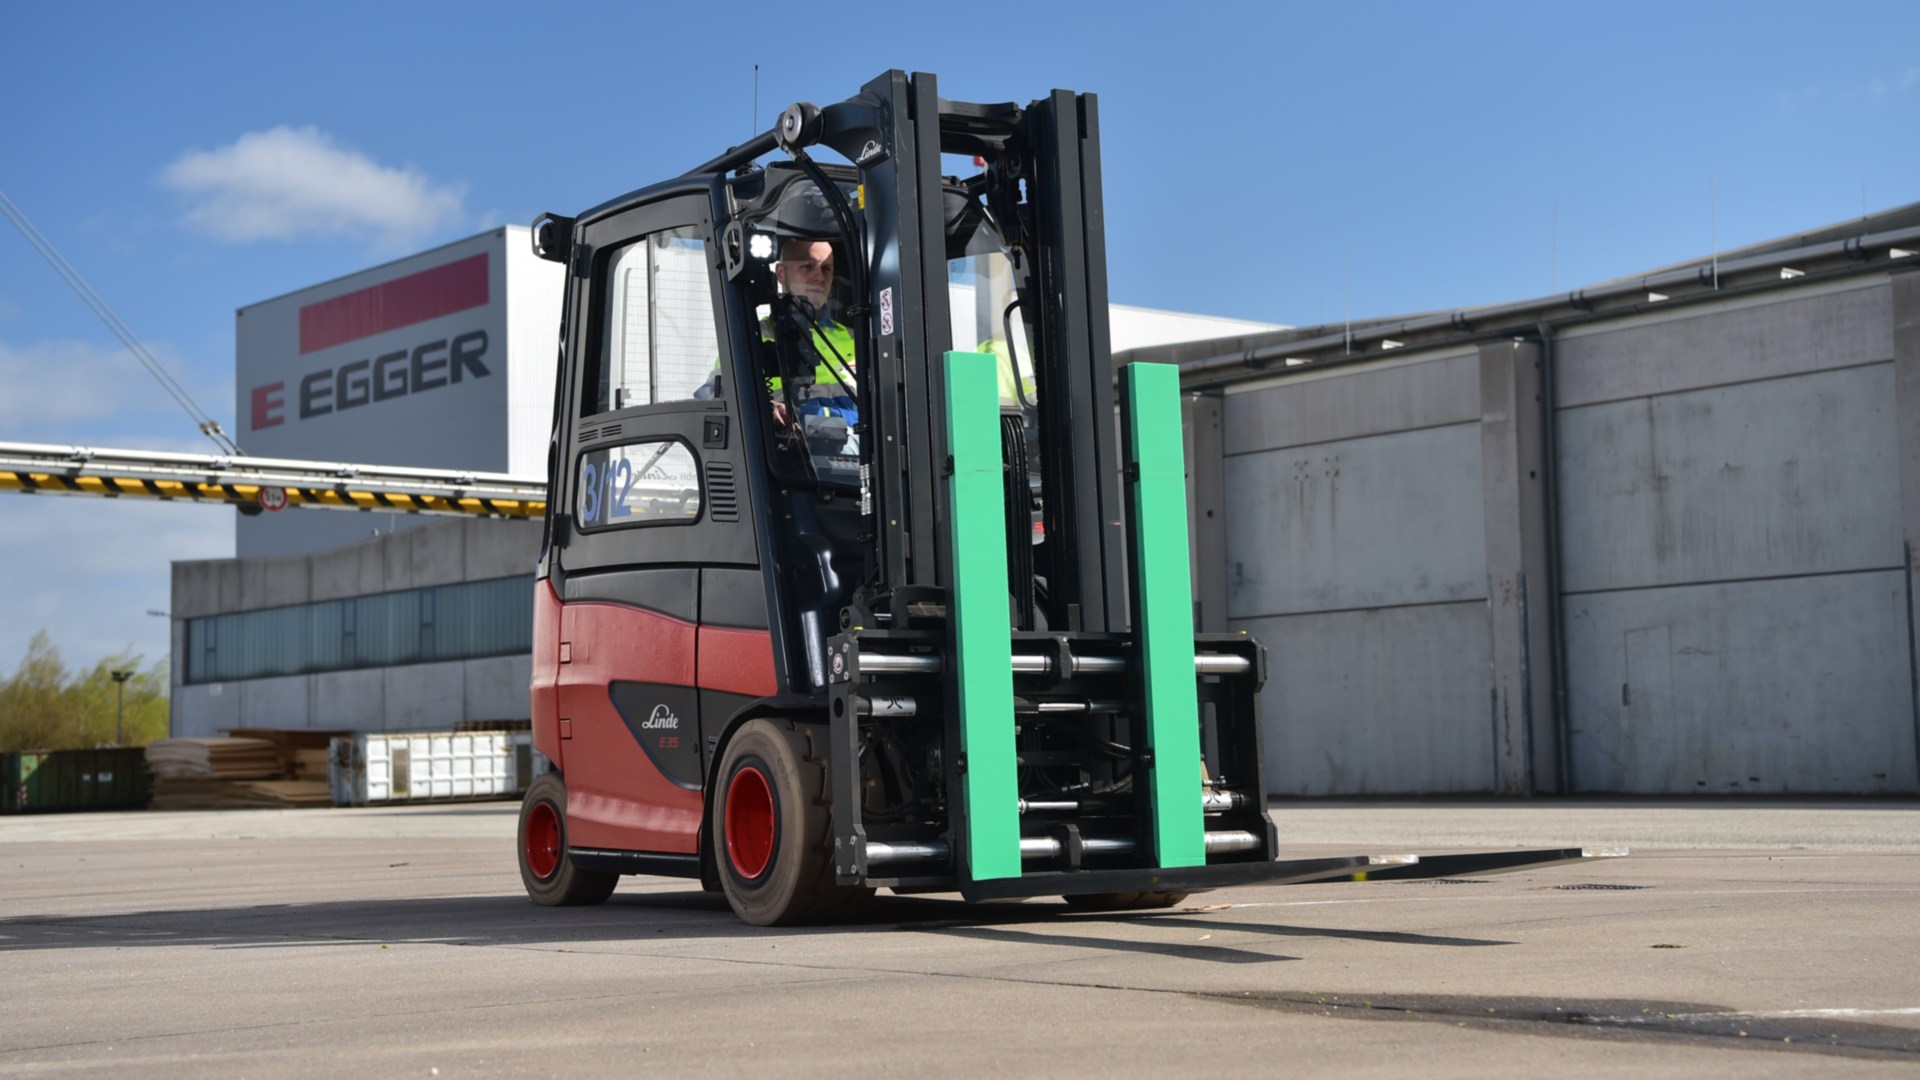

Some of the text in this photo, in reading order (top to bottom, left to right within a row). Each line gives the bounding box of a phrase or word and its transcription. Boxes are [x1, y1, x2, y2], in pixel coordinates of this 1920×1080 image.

[855, 139, 882, 164] Linde
[300, 329, 492, 420] EGGER
[582, 458, 632, 522] 3/12
[641, 703, 679, 729] Linde
[658, 736, 679, 749] E35
